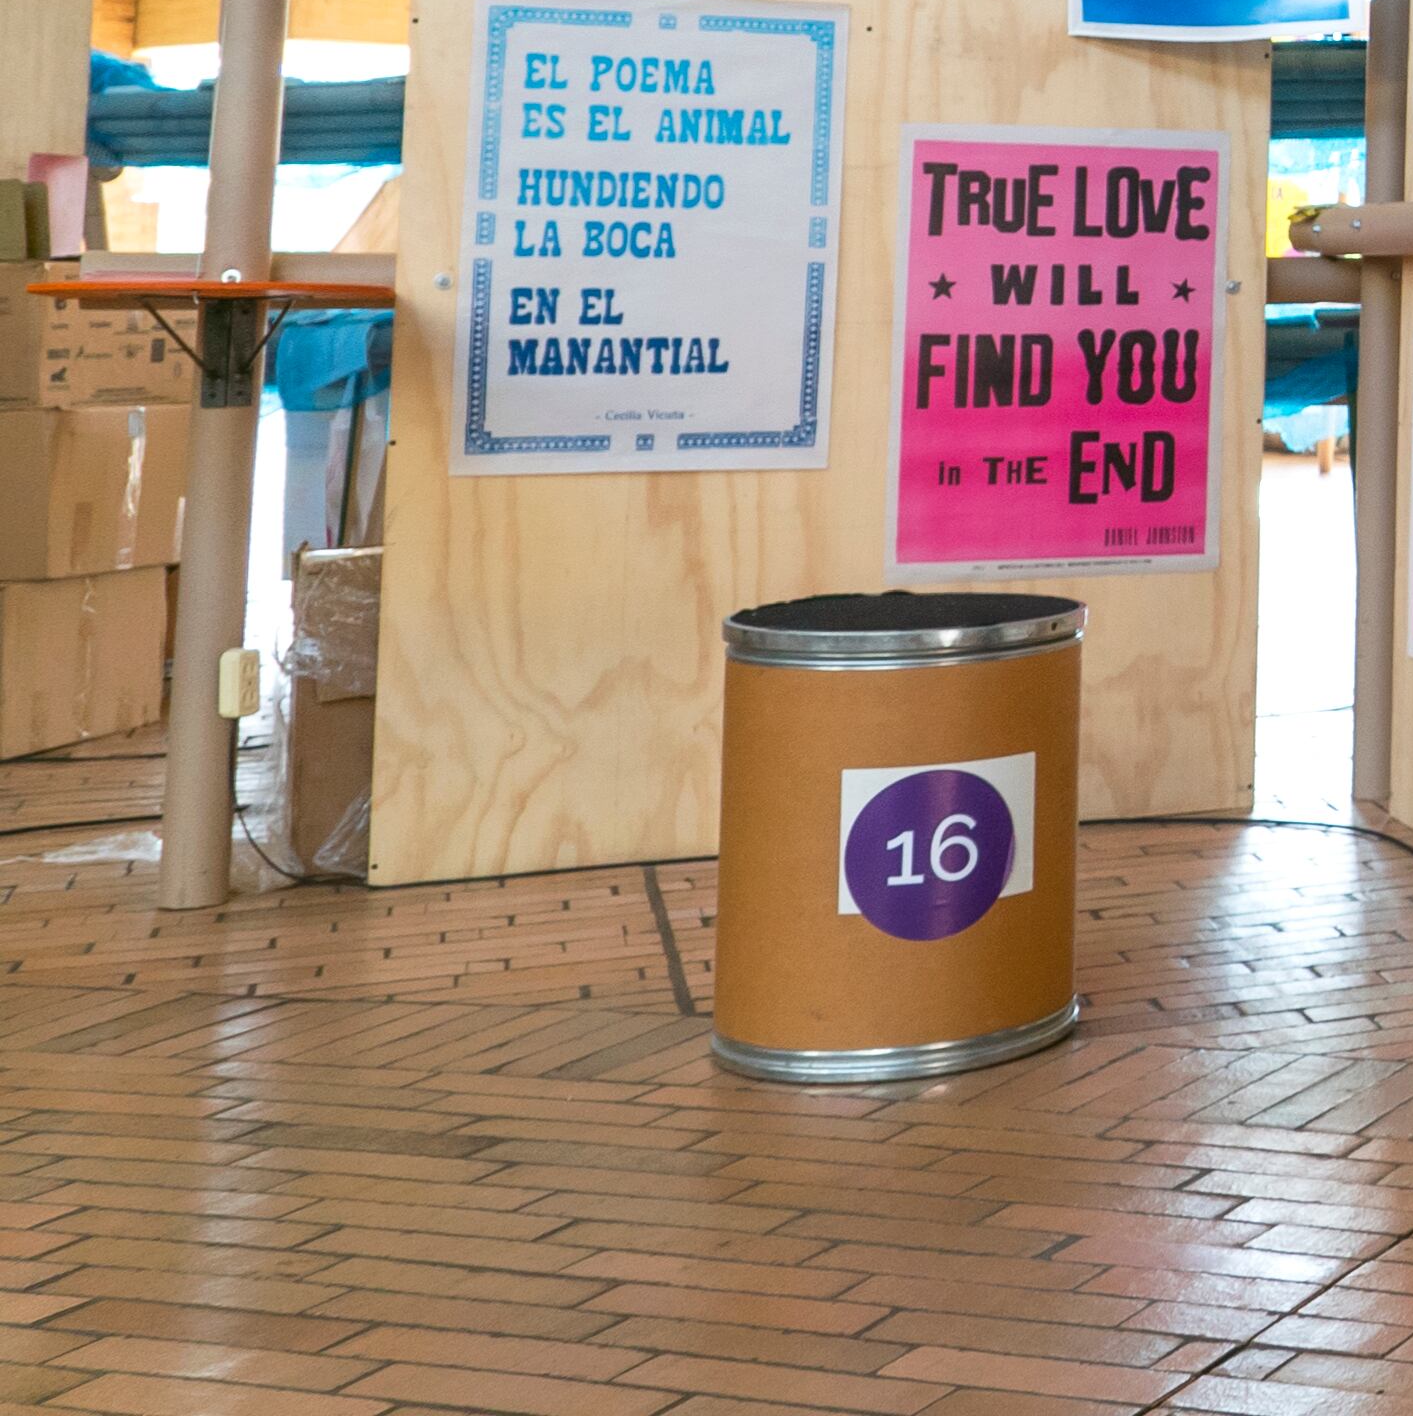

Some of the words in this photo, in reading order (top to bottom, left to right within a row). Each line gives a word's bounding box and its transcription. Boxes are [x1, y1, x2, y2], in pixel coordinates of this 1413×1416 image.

[524, 52, 568, 90] EL
[589, 56, 716, 95] POEMA
[521, 103, 566, 139] ES
[587, 105, 631, 142] EL
[655, 109, 791, 146] ANIMAL
[517, 168, 725, 210] HUNDIENDO
[923, 162, 1059, 237] TRUE
[1073, 165, 1210, 241] LOVE
[514, 220, 562, 258] LA
[583, 221, 676, 259] BOCA
[991, 263, 1139, 306] WILL
[509, 288, 560, 325] EN
[579, 288, 624, 325] EL
[507, 336, 729, 376] MANANTIAL
[916, 333, 1054, 410] FIND
[1077, 328, 1199, 405] YOU
[938, 461, 961, 486] in
[982, 456, 1049, 485] THE
[1068, 431, 1175, 505] END
[886, 813, 979, 886] 16
